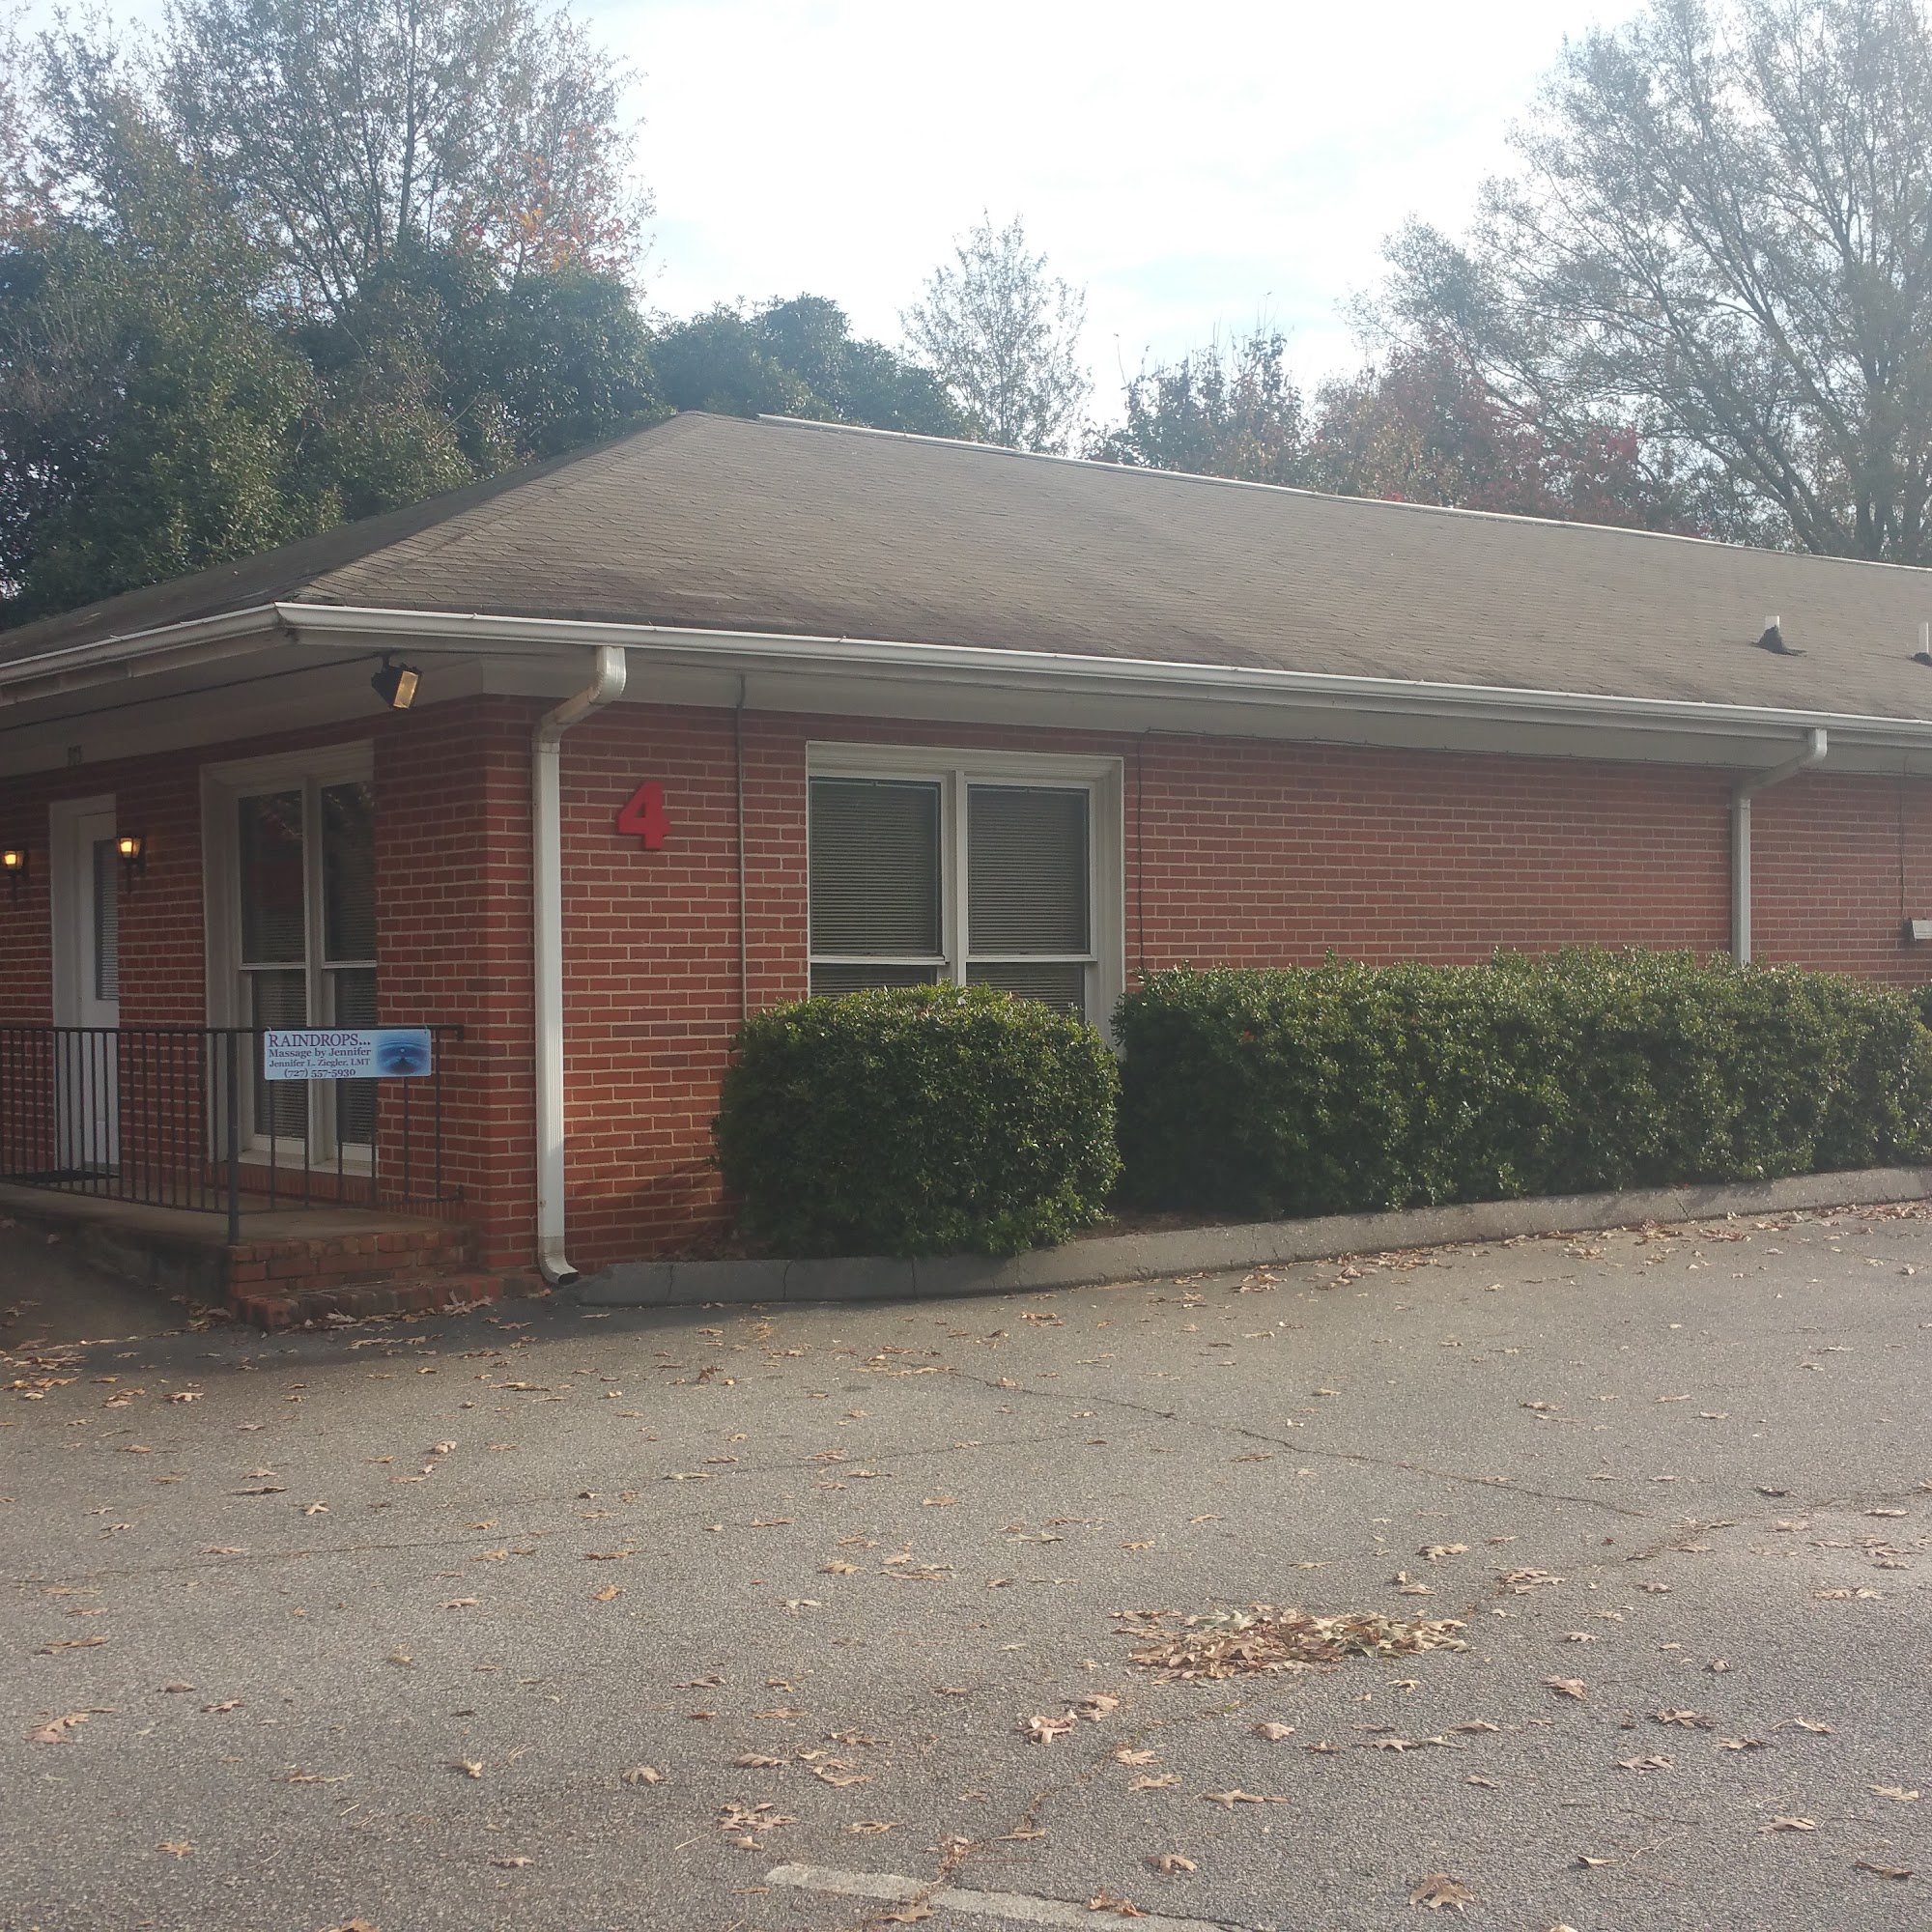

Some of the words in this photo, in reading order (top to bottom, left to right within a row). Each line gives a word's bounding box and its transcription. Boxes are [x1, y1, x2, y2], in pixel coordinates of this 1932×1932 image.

[617, 781, 670, 849] 4
[269, 1034, 371, 1047] RAINDROPS...
[269, 1048, 312, 1059] Massage
[314, 1048, 327, 1058] by
[328, 1047, 372, 1057] Jennifer
[284, 1068, 308, 1078] (727)
